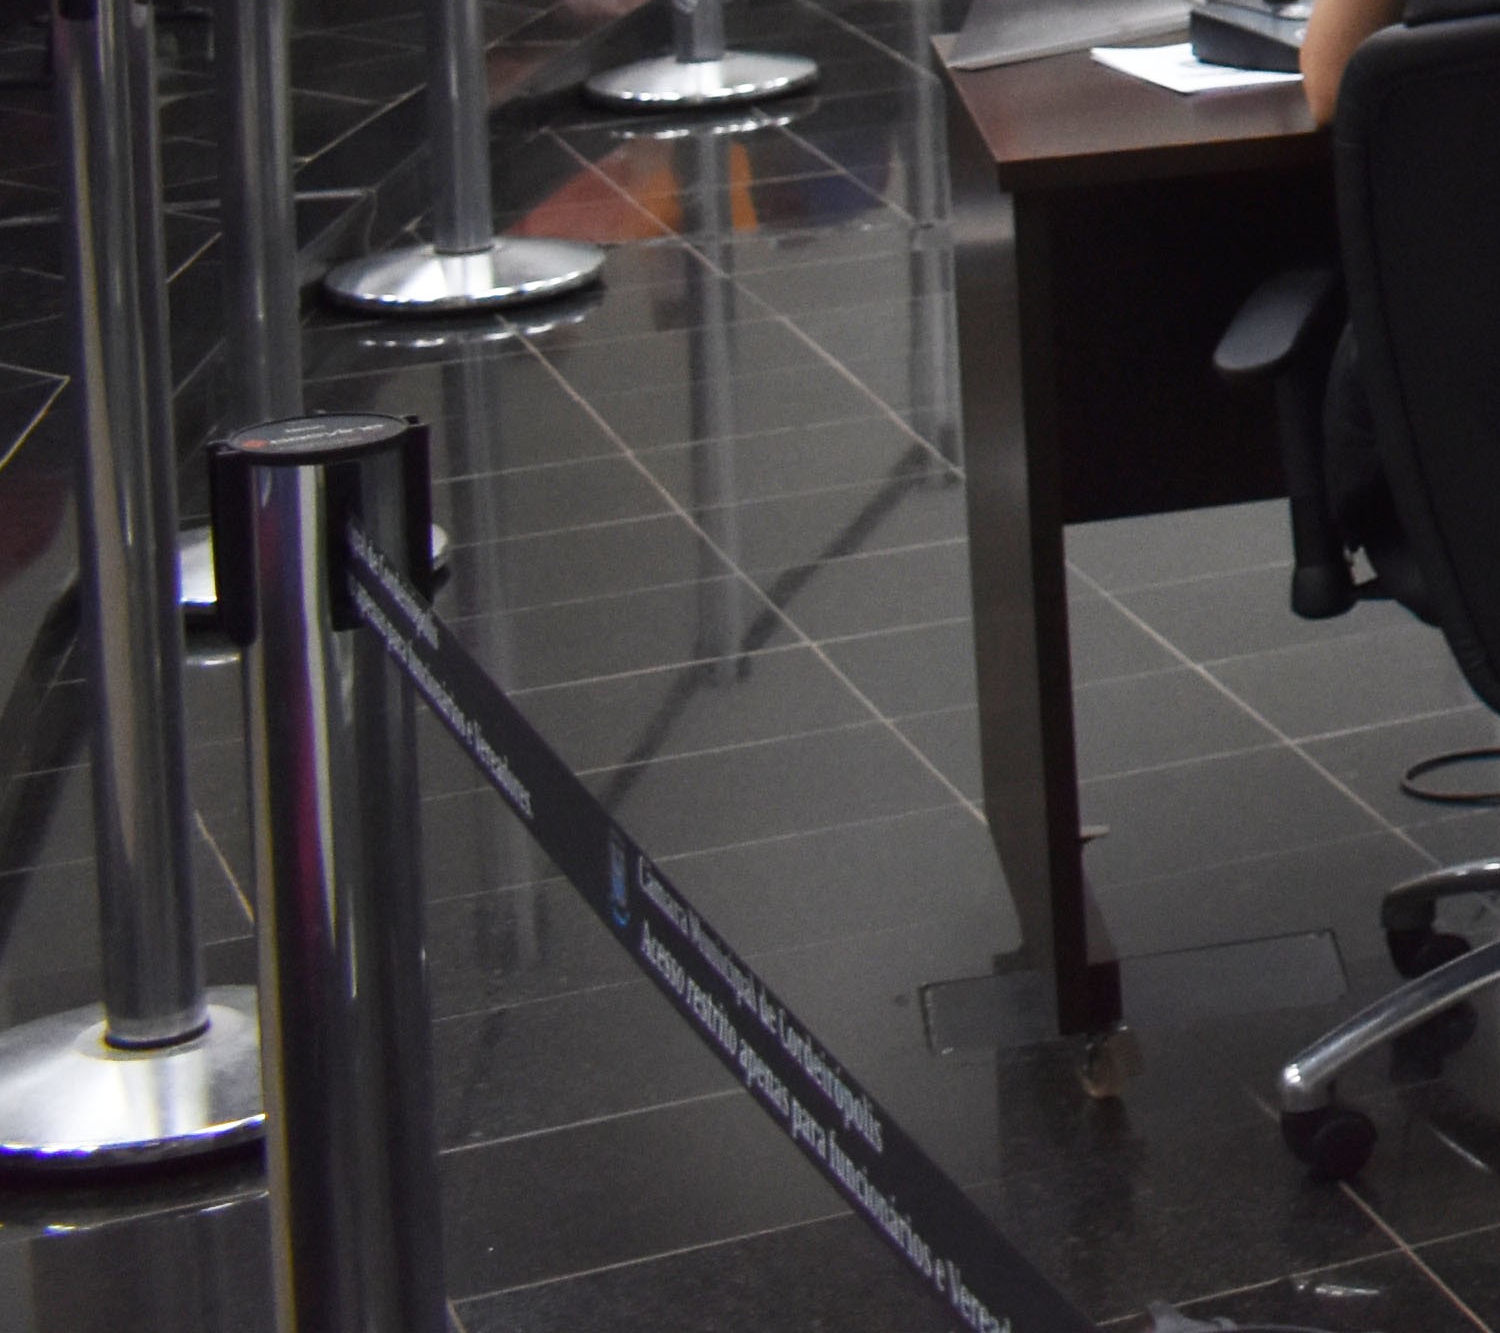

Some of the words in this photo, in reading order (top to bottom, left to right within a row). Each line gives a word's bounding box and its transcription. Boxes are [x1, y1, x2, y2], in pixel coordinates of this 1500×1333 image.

[639, 855, 688, 937] Câmara
[688, 909, 757, 1015] Municipal
[758, 986, 776, 1035] de
[778, 1009, 883, 1154] Cordeirópolis
[642, 920, 686, 995] Acesso
[687, 978, 738, 1056] restrito
[738, 1038, 790, 1119] apenas
[791, 1096, 827, 1161] para
[828, 1128, 933, 1277] funcionários
[934, 1258, 945, 1292] e
